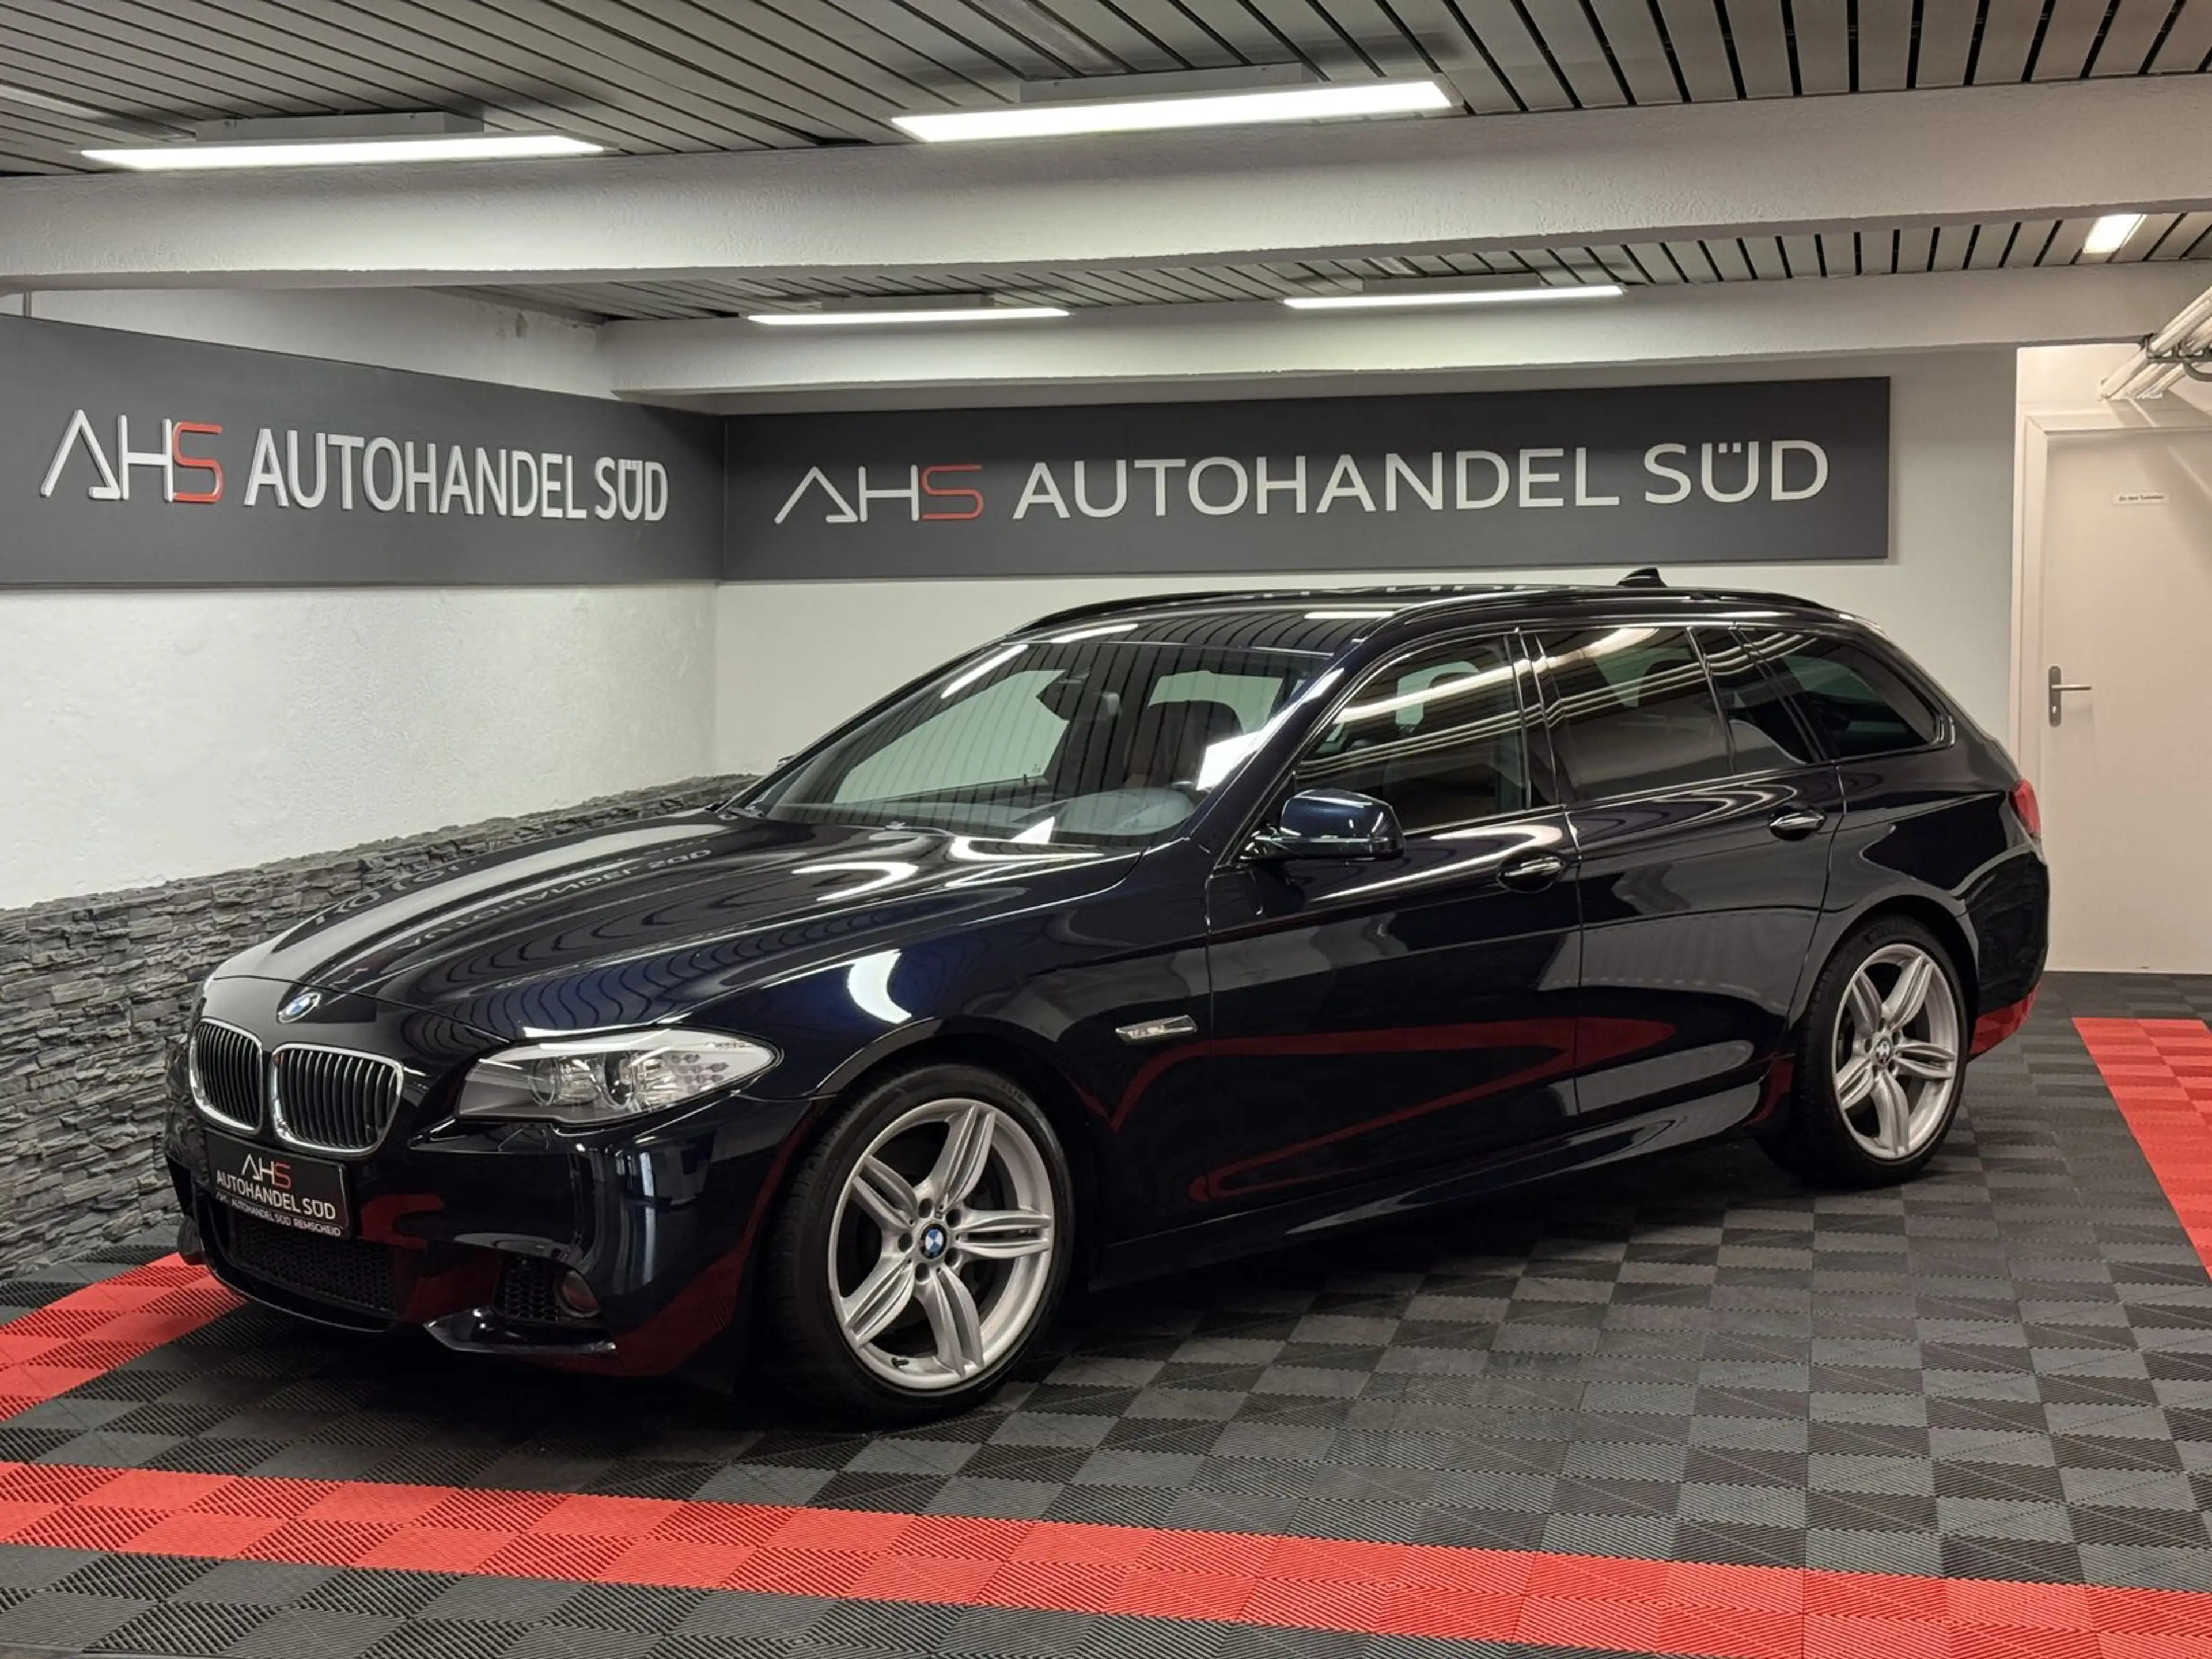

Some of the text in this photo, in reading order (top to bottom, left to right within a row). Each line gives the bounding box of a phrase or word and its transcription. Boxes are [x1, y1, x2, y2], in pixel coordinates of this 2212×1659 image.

[41, 408, 668, 521] AHS AUTOHANDEL SÜD
[774, 441, 1828, 524] AHS AUTOHANDEL SÜD
[216, 1169, 301, 1213] AUTOHANDEL
[241, 1153, 292, 1190] AHS
